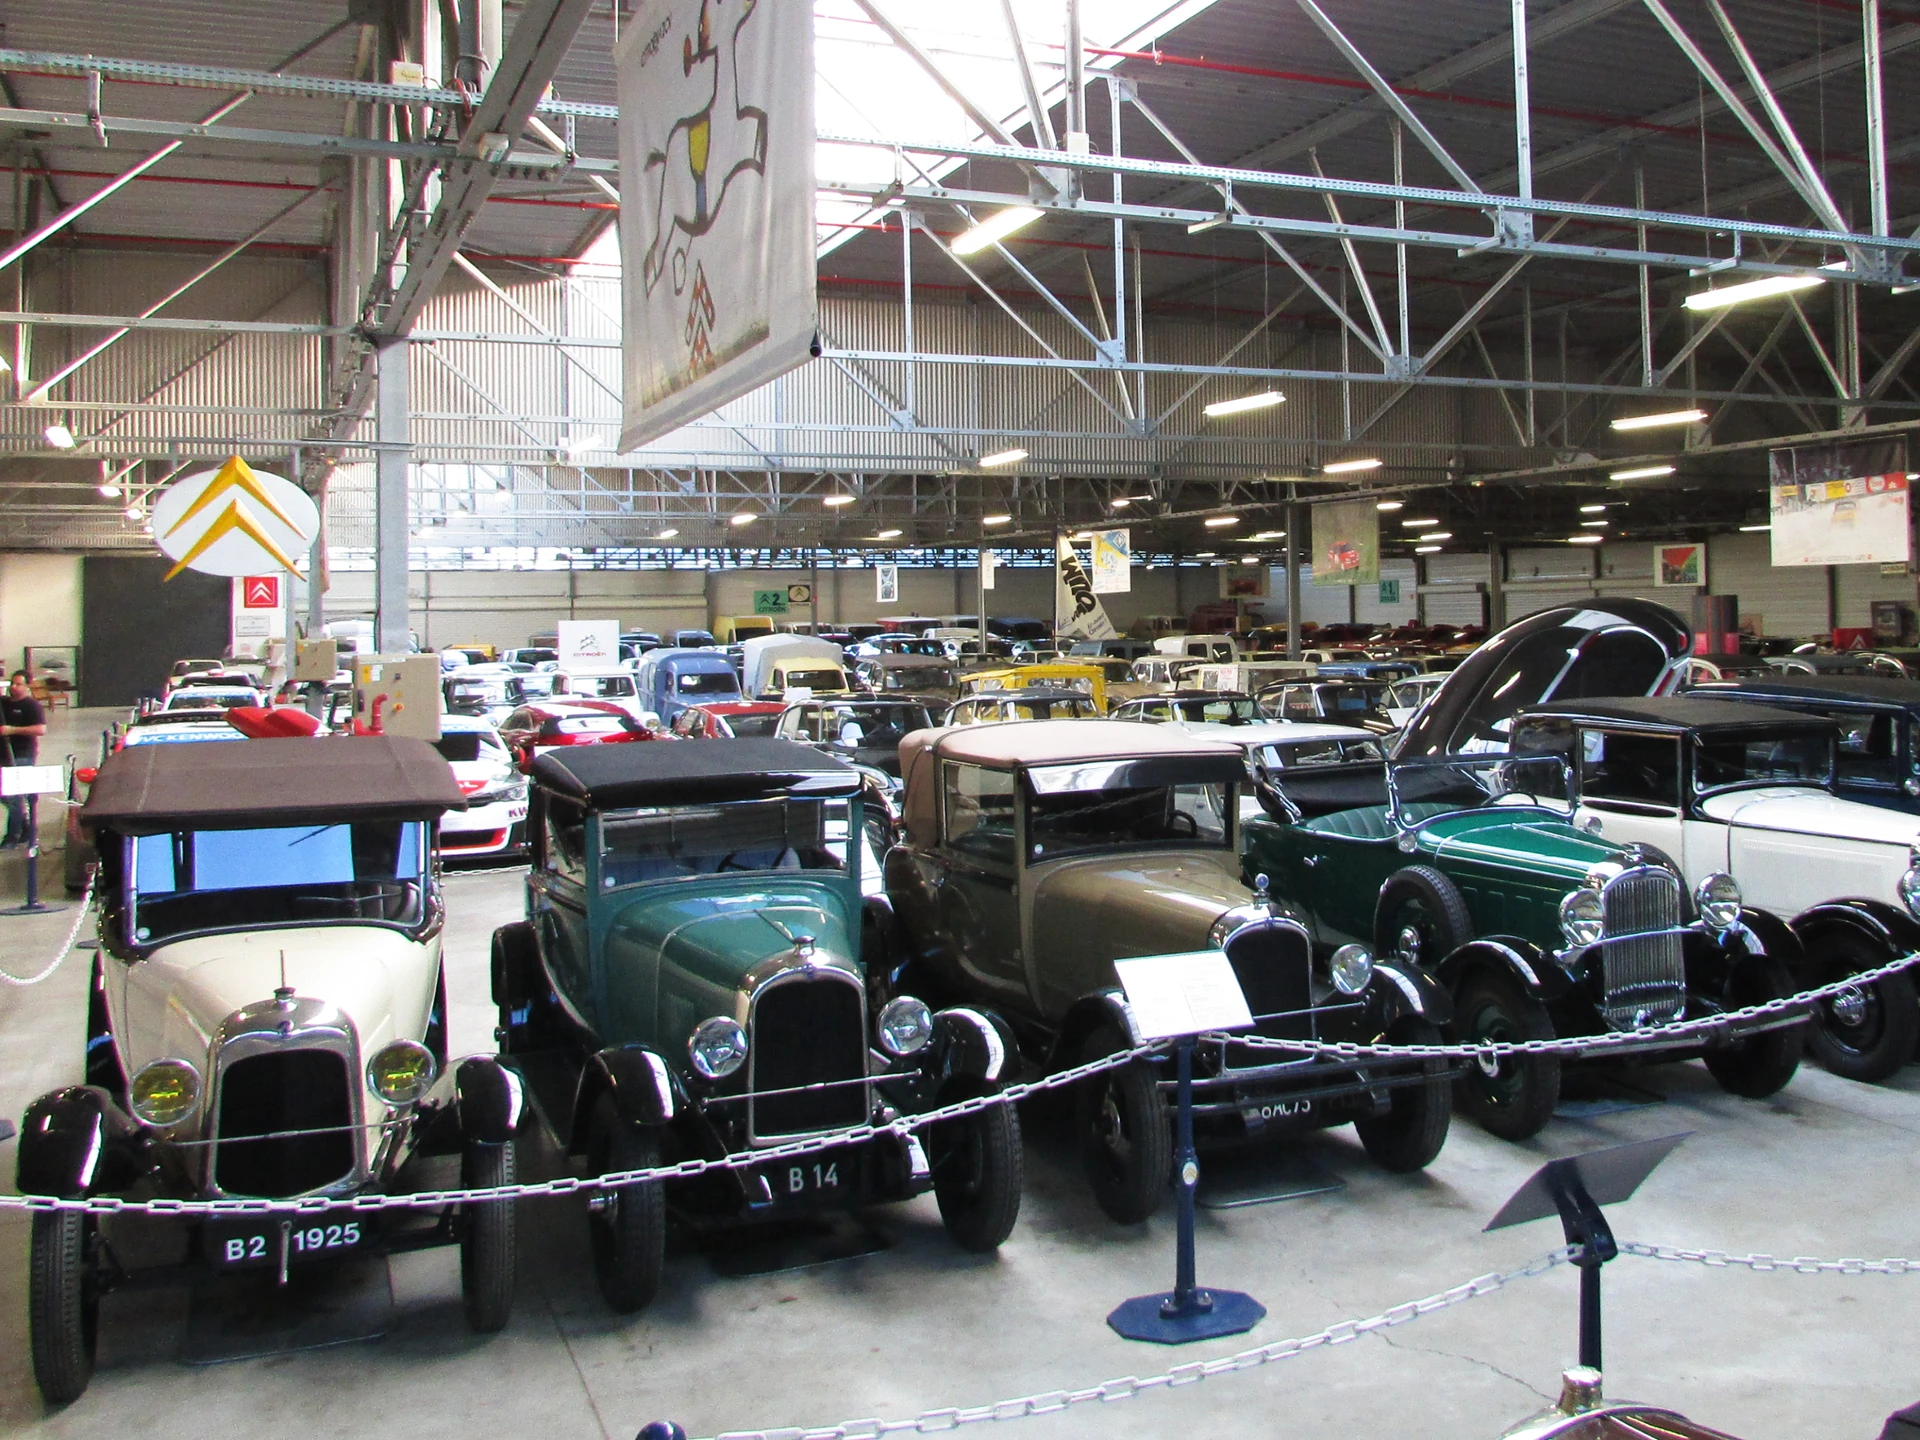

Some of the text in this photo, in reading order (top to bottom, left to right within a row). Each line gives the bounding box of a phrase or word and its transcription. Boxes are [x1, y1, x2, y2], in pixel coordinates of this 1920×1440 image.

[166, 732, 243, 741] KENWOO
[789, 1162, 838, 1192] B 14
[225, 1222, 361, 1261] B2 1925
